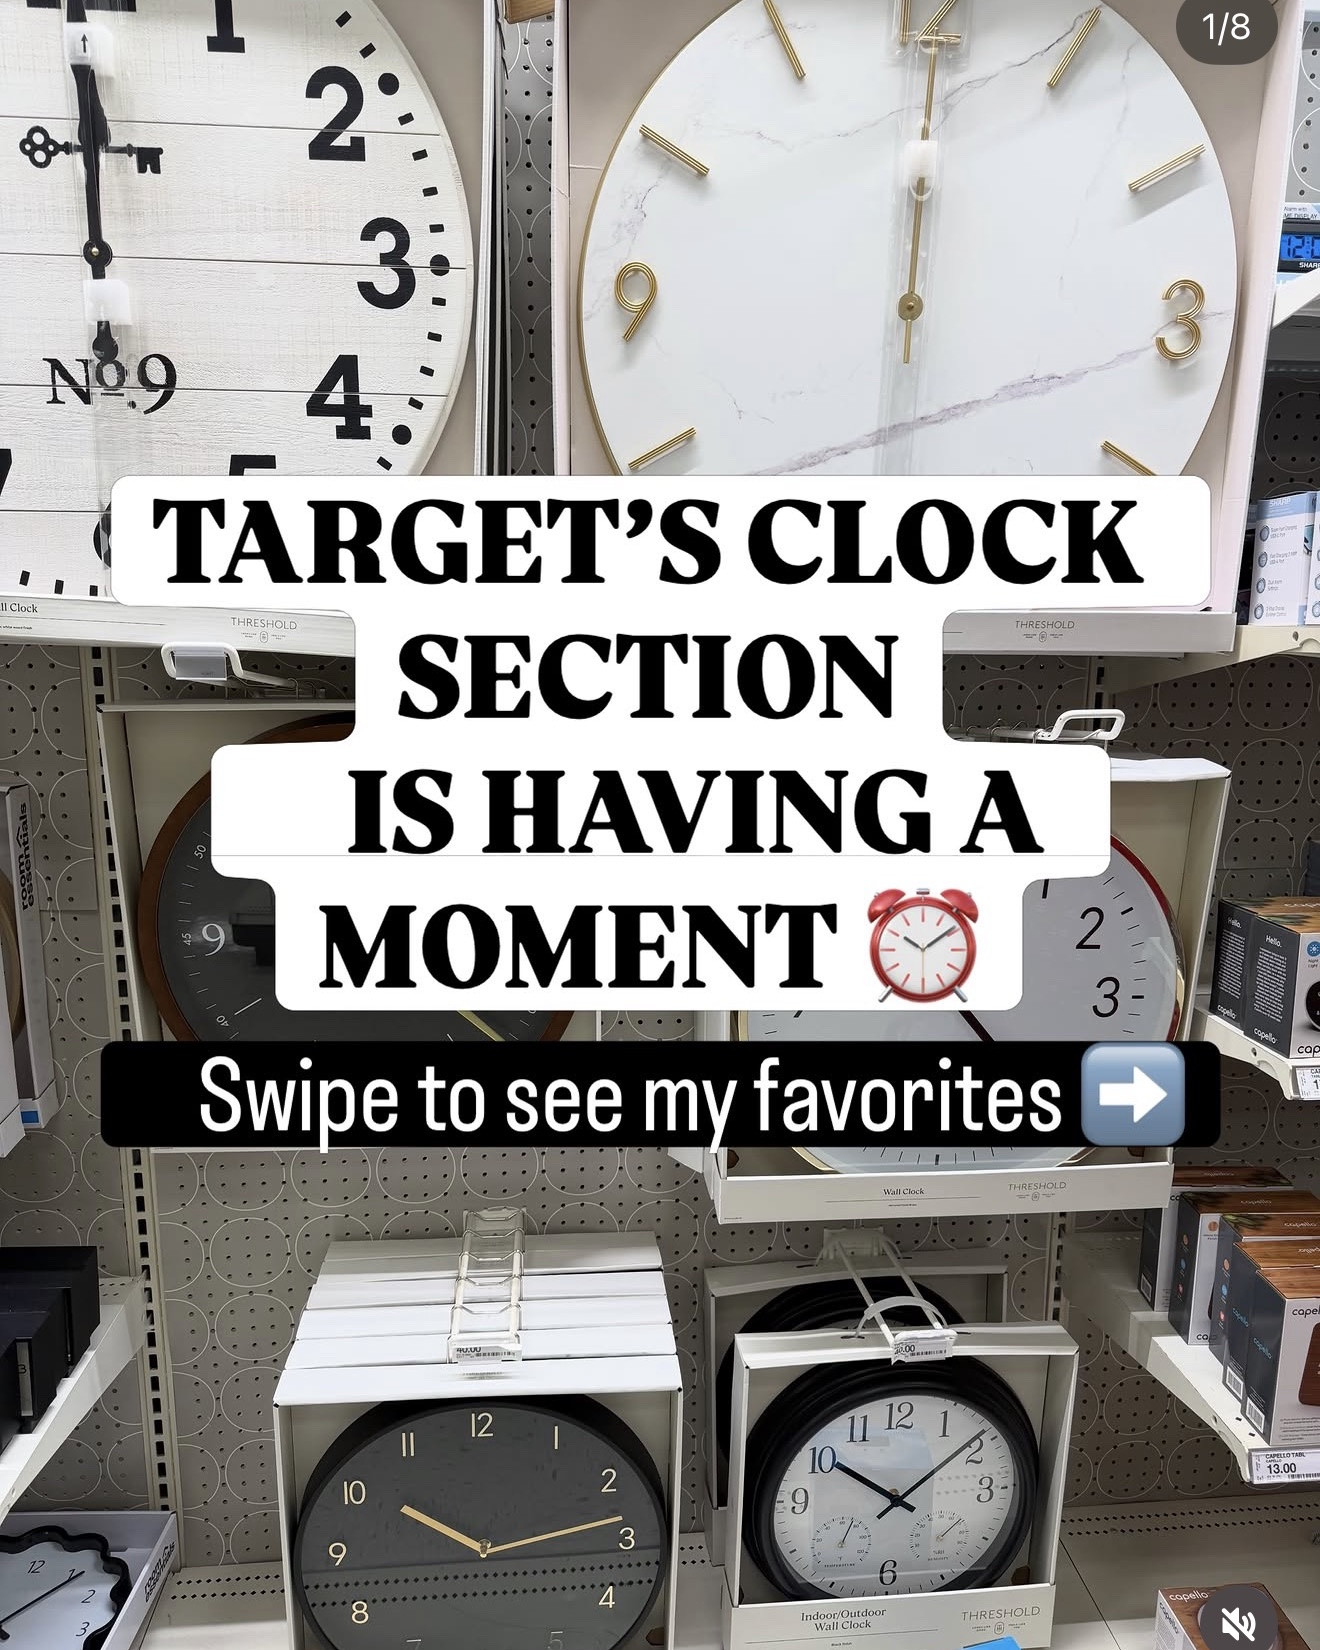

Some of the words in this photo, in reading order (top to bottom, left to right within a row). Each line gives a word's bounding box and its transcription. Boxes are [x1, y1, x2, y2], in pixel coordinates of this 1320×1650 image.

[305, 66, 366, 162] 2
[357, 217, 416, 310] 3
[614, 261, 657, 341] 9
[1155, 278, 1205, 361] 3
[306, 355, 373, 440] 4
[10, 603, 38, 613] Clock
[230, 616, 298, 630] THRESHOLD
[1015, 620, 1075, 629] THRESHOLD
[19, 803, 35, 908] essentials
[194, 844, 207, 859] 50
[17, 853, 30, 911] room
[1076, 906, 1105, 950] 2
[1227, 916, 1242, 929] Hello.
[183, 932, 193, 946] 45
[201, 923, 226, 957] 9
[1265, 935, 1282, 948] Hello.
[1091, 977, 1120, 1018] 3
[215, 1015, 230, 1029] 40
[1217, 1004, 1237, 1020] capello
[1253, 1027, 1277, 1045] capello
[883, 1188, 901, 1196] Wall
[902, 1187, 925, 1195] Clock
[1007, 1181, 1067, 1191] THRESHOLD
[1232, 1307, 1250, 1328] capello
[1253, 1337, 1273, 1360] capello
[471, 1413, 494, 1438] 12
[885, 1401, 914, 1430] 12
[938, 1410, 950, 1438] 1
[846, 1414, 870, 1443] 11
[401, 1432, 415, 1457] 11
[965, 1437, 984, 1465] 2
[808, 1445, 837, 1475] 10
[1267, 1463, 1297, 1474] 13.00
[343, 1480, 366, 1505] 10
[601, 1469, 617, 1493] 2
[976, 1475, 995, 1503] 3
[791, 1487, 809, 1515] 9
[617, 1527, 635, 1550] 3
[328, 1542, 347, 1566] 9
[27, 1560, 46, 1574] 12
[144, 1558, 162, 1595] room
[145, 1541, 175, 1603] essentials
[879, 1559, 898, 1586] 6
[81, 1589, 96, 1604] 2
[598, 1585, 616, 1609] 4
[1169, 1590, 1209, 1602] capello
[351, 1600, 369, 1624] 8
[801, 1608, 887, 1621] Indoor/Outdoor
[961, 1606, 1041, 1621] THRESHOLD
[76, 1621, 90, 1637] 3
[814, 1621, 839, 1632] Wall
[841, 1619, 872, 1630] Clock
